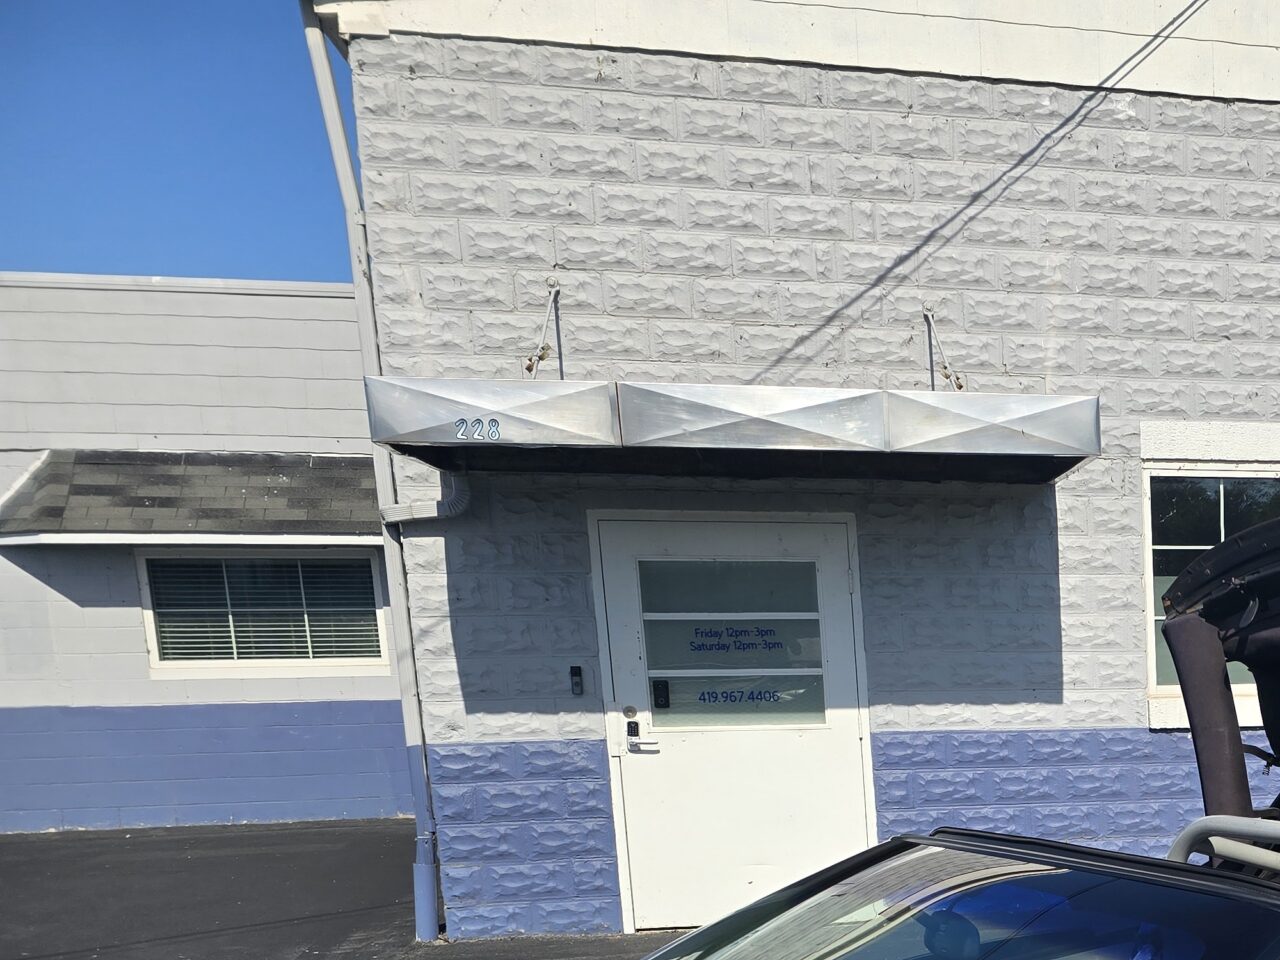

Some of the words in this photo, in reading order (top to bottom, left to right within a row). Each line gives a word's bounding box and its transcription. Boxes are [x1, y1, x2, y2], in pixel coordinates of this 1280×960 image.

[455, 418, 501, 441] 228
[694, 628, 724, 639] Friday
[725, 627, 776, 639] 12pm-3pm
[689, 641, 731, 652] Saturday
[733, 640, 783, 651] 12pm-3pm
[698, 690, 780, 703] 419.967.4406
